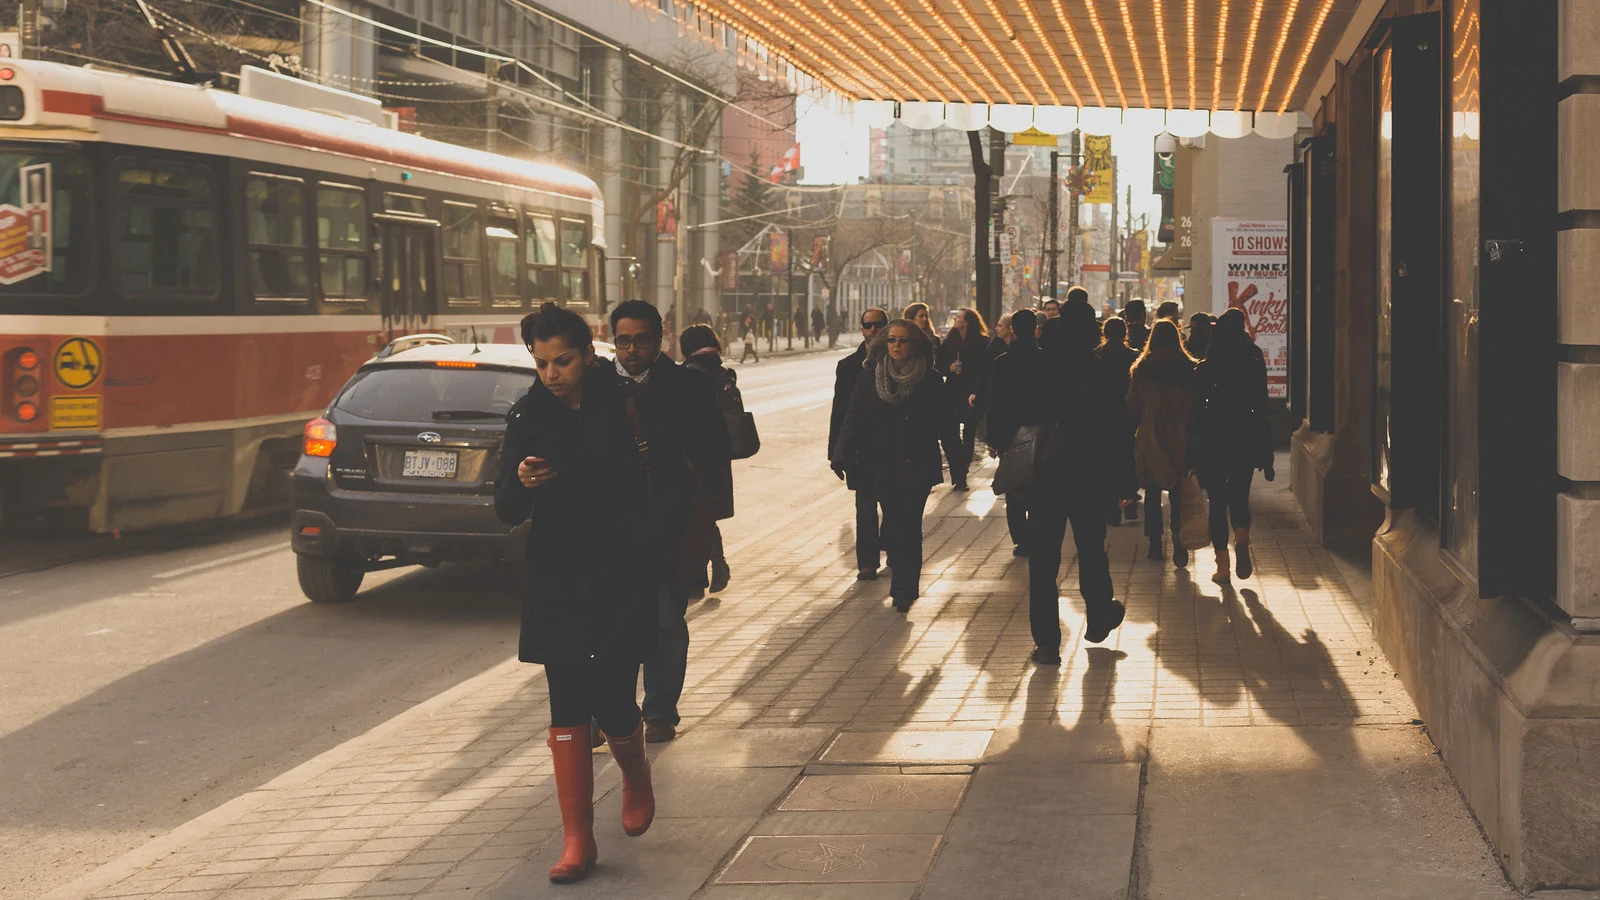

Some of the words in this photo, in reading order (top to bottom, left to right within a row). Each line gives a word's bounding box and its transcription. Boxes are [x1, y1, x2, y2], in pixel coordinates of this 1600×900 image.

[1180, 216, 1192, 228] 26
[1180, 236, 1192, 247] 26
[1231, 236, 1245, 250] 10
[1267, 385, 1285, 396] day!
[404, 456, 431, 470] BTJV
[436, 457, 456, 471] 088
